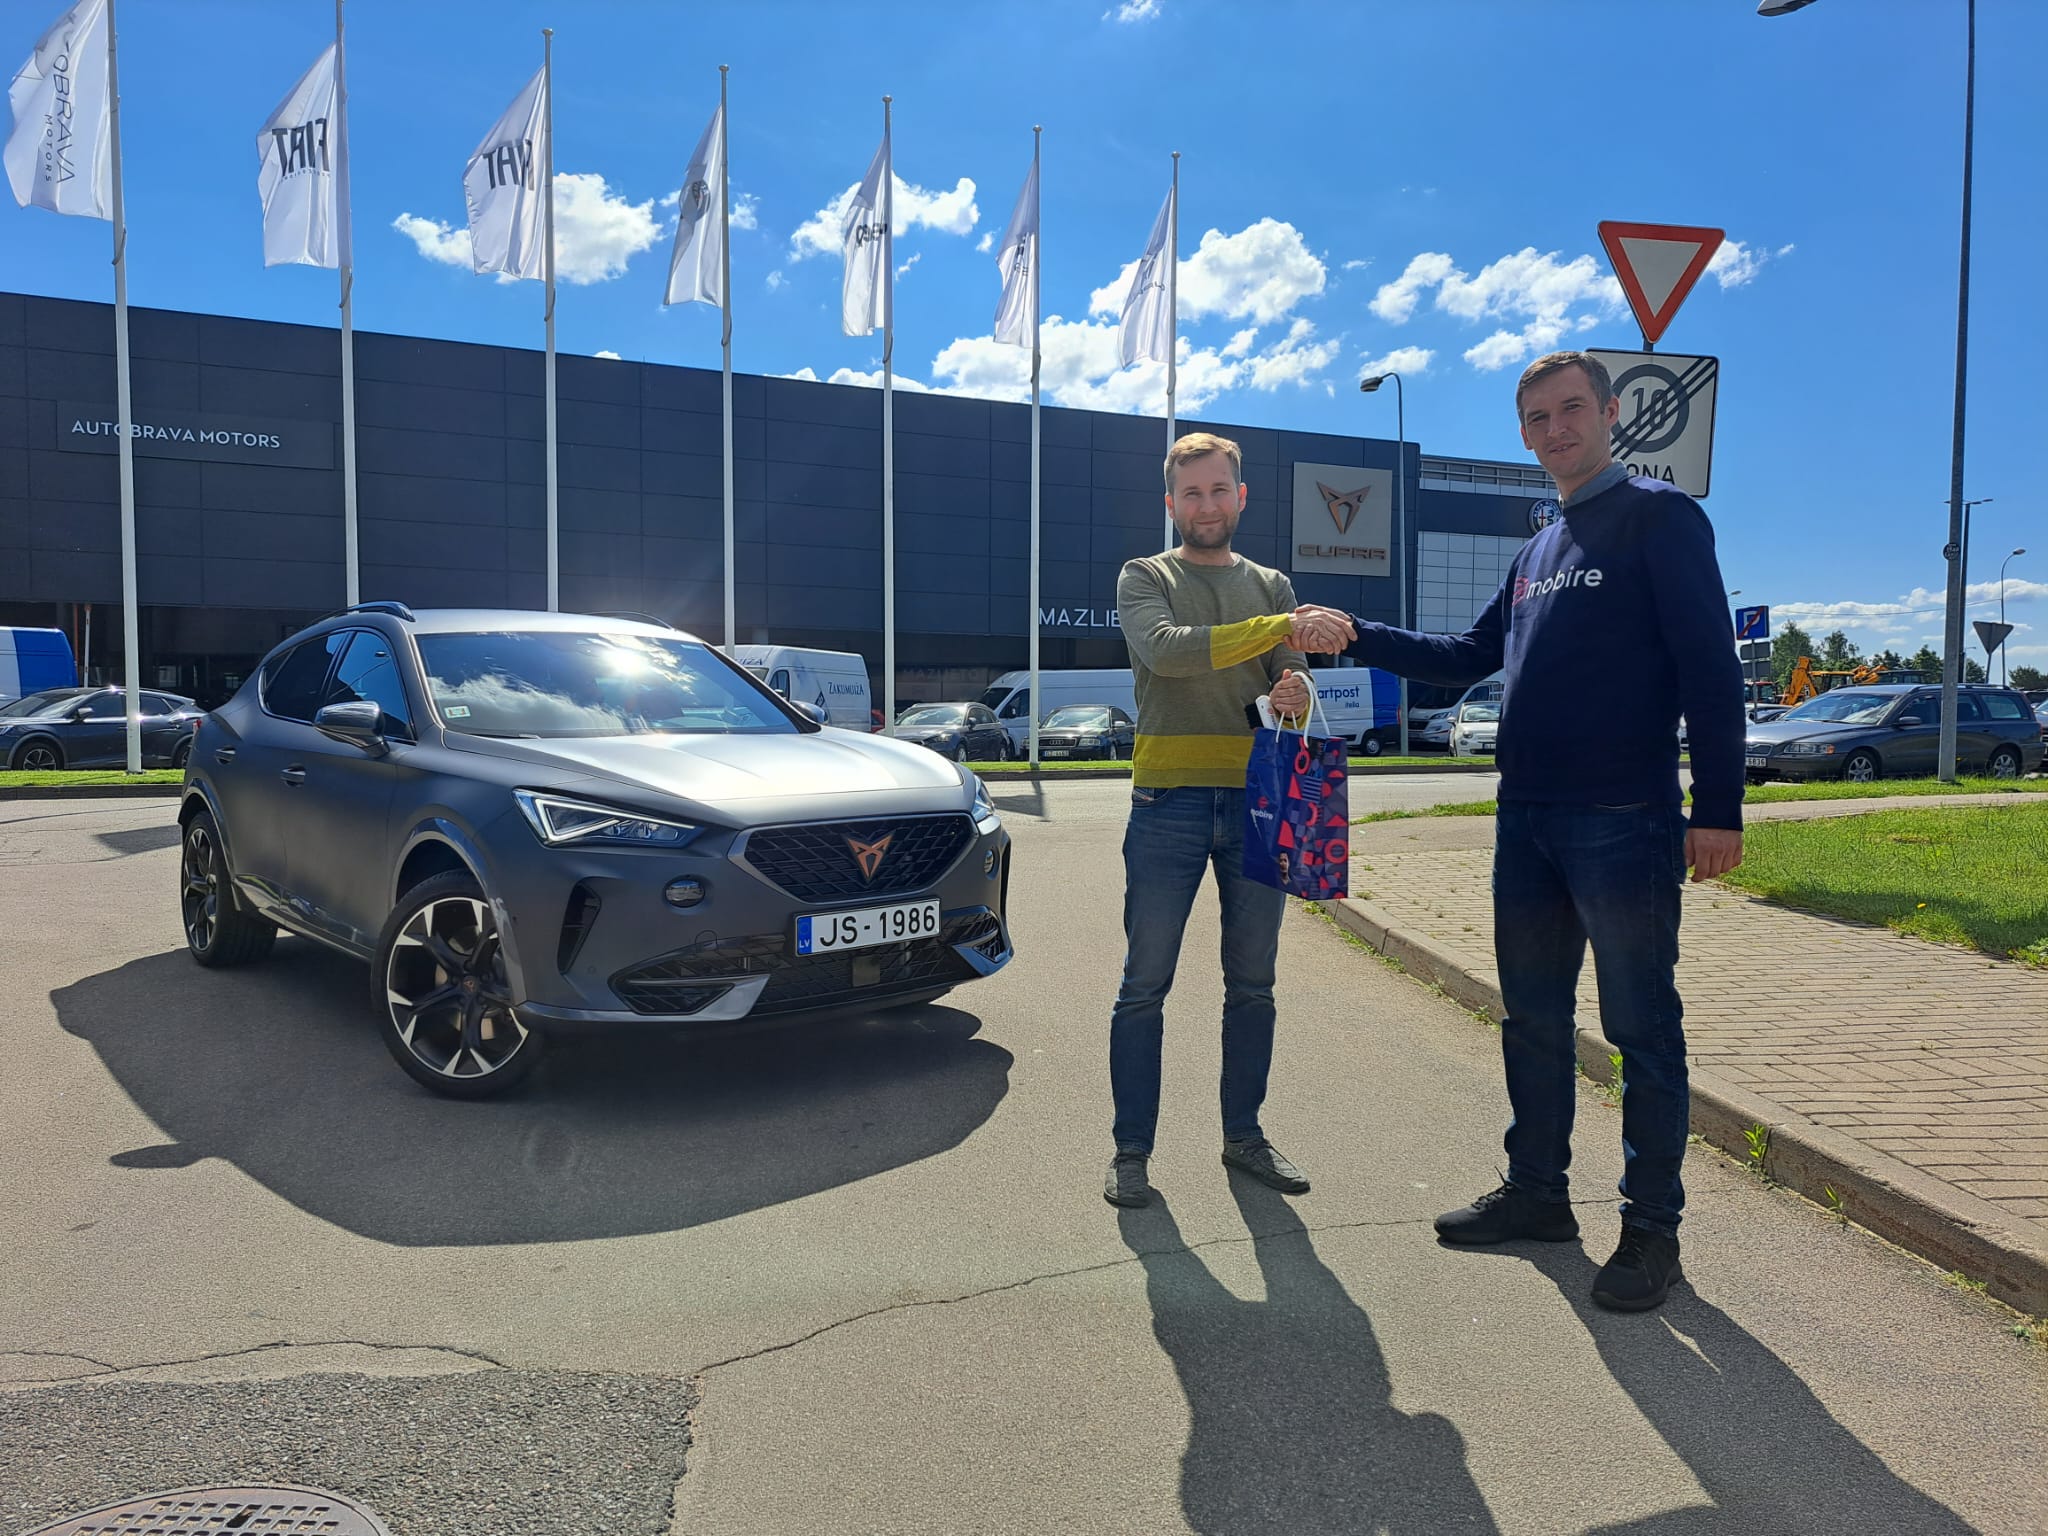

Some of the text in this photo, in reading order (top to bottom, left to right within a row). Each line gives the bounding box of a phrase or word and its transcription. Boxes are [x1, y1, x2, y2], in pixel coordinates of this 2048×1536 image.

[44, 114, 52, 182] MOTORS
[1632, 387, 1668, 431] 10
[199, 430, 280, 449] MOTORS
[1626, 463, 1676, 485] ONA
[1298, 544, 1387, 560] CUPRA
[1526, 565, 1603, 600] mobire
[820, 905, 935, 947] JS-1986
[800, 938, 810, 948] LV
